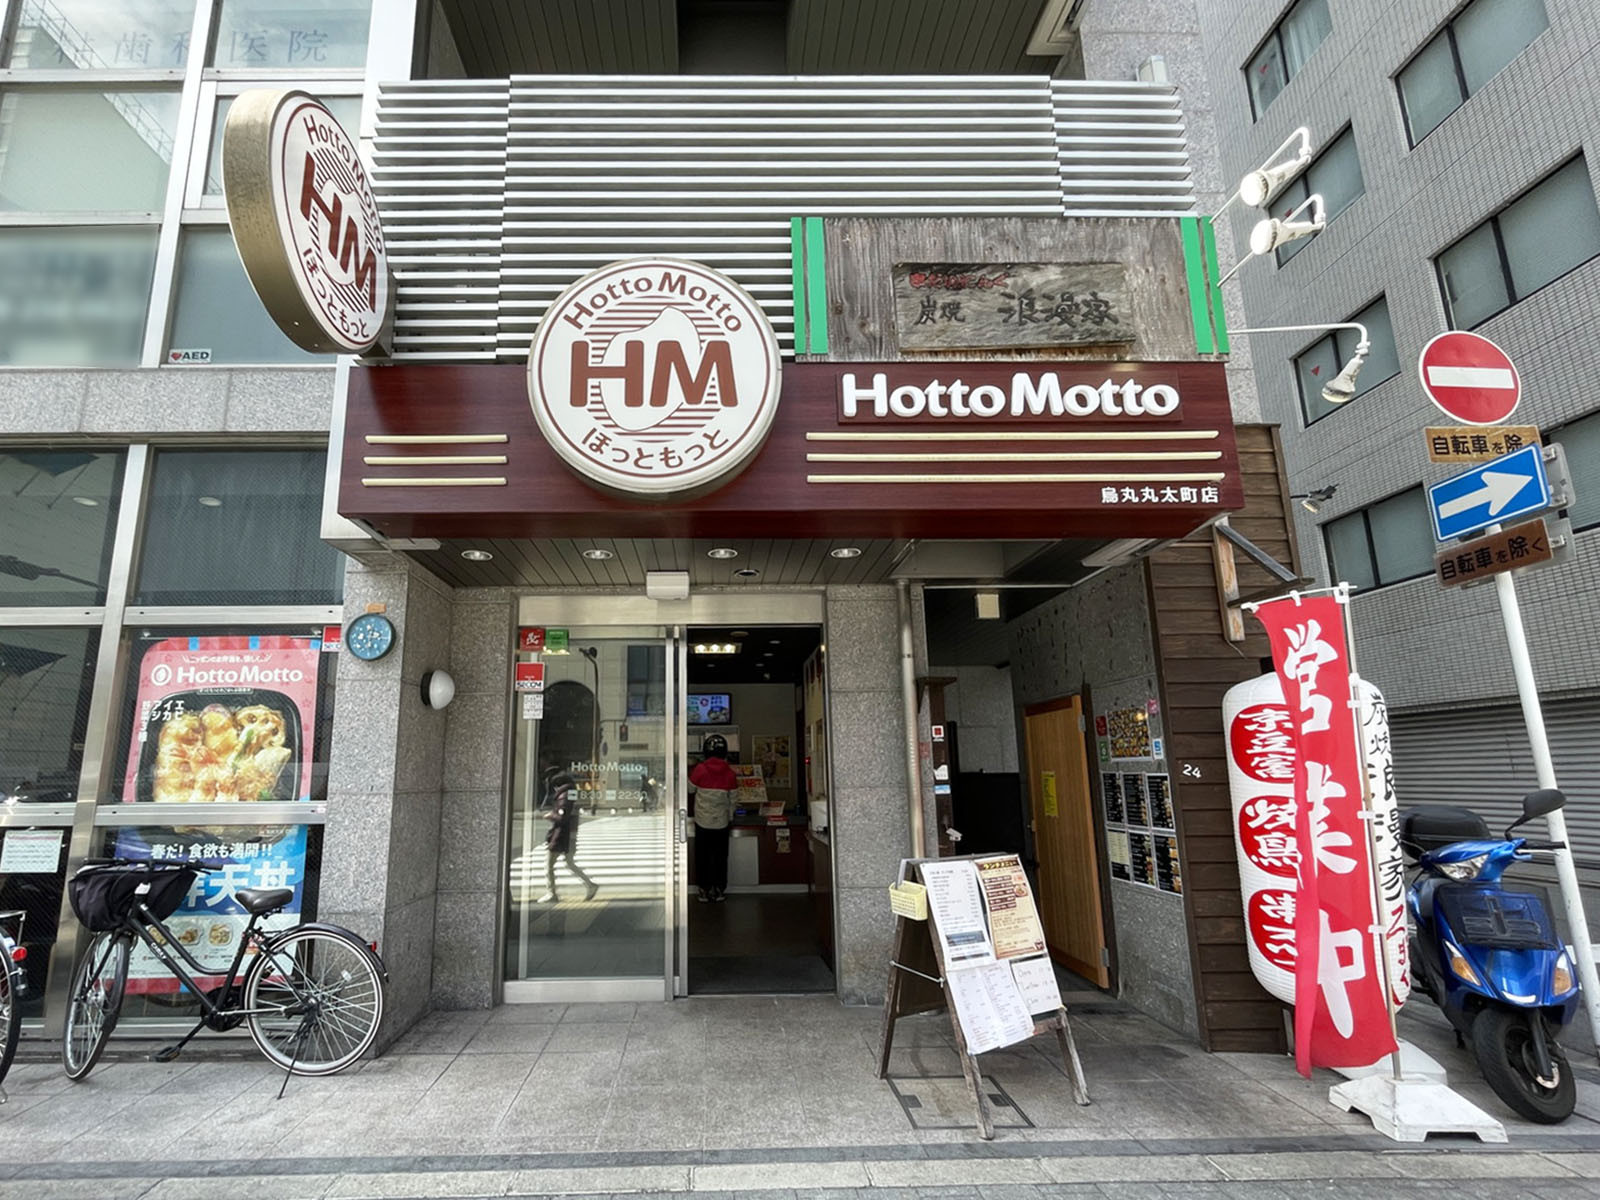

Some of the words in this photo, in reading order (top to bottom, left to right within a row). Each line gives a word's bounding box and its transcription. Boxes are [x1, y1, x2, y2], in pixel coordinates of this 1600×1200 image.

[300, 151, 376, 313] HM
[303, 247, 370, 338] ほっともっと
[182, 351, 209, 360] AED
[569, 340, 739, 408] HM
[581, 427, 730, 471] ほっともっと
[1432, 434, 1523, 455] 自転車を除
[1440, 535, 1544, 580] 自転車を除く
[1182, 764, 1202, 778] 24
